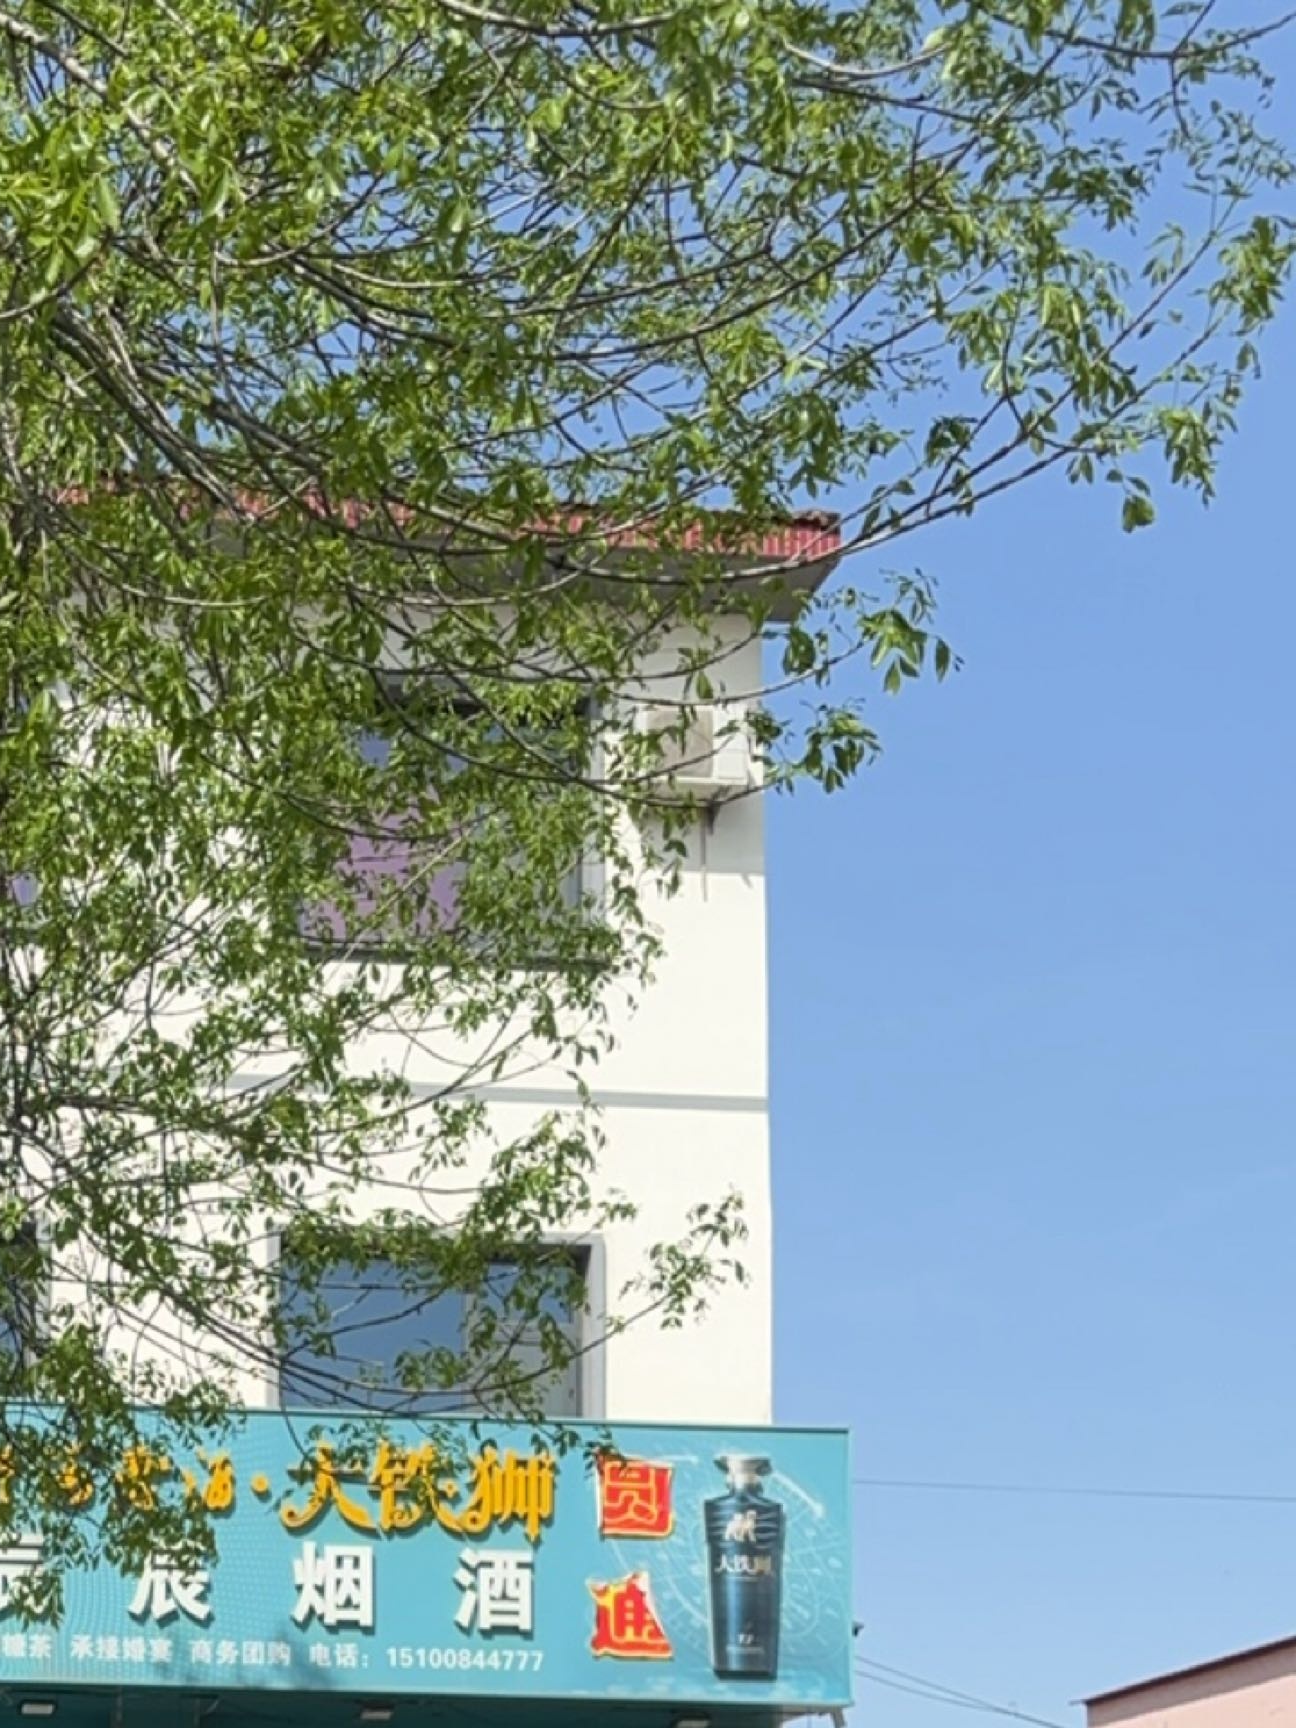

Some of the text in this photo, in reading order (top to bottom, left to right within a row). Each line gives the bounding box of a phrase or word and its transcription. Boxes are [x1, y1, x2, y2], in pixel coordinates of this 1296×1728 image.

[70, 1634, 172, 1663] 承接婚宴
[191, 1640, 292, 1666] 商务团购
[387, 1646, 544, 1672] 15100844777
